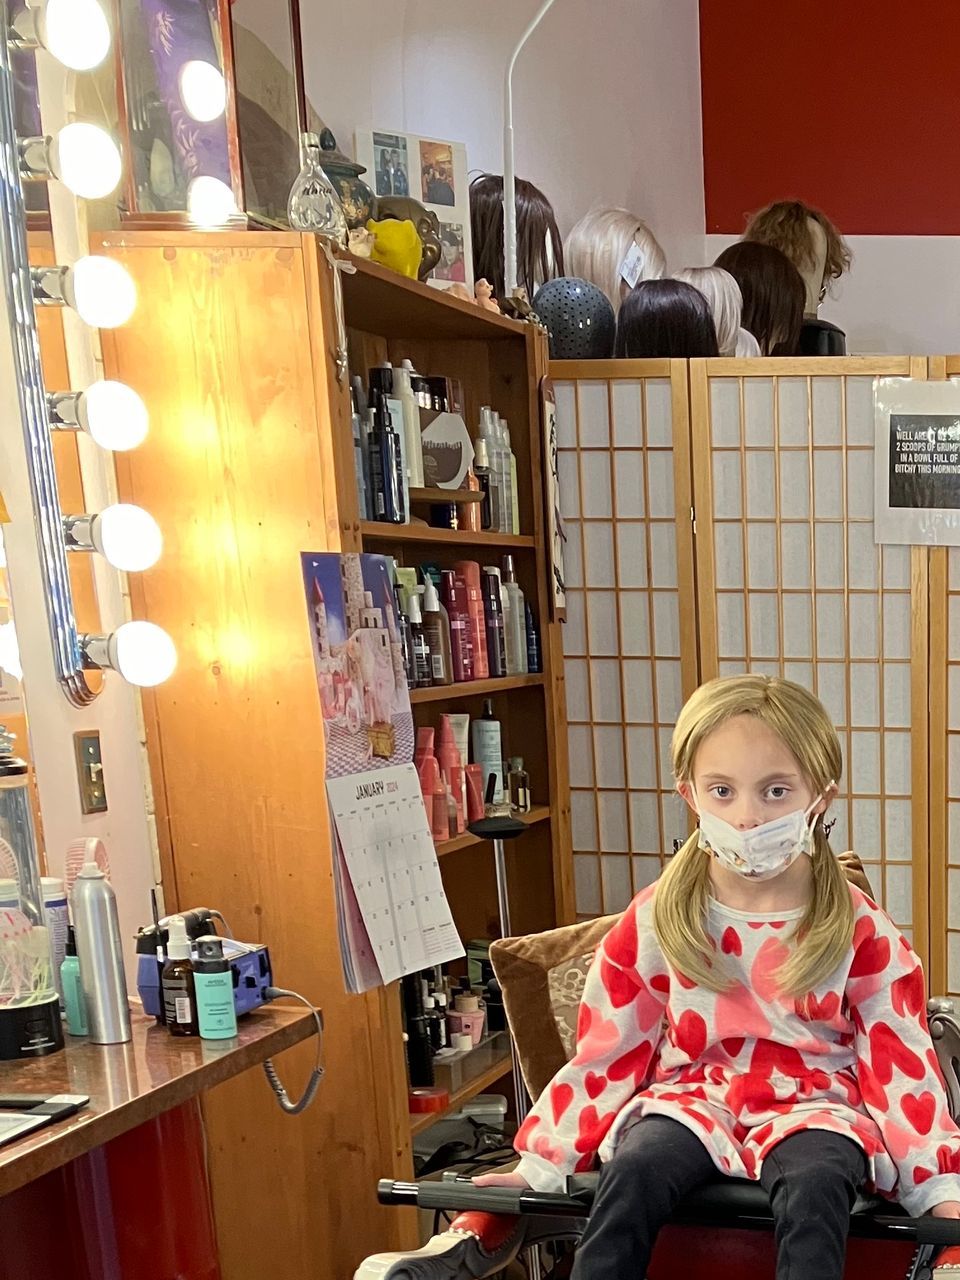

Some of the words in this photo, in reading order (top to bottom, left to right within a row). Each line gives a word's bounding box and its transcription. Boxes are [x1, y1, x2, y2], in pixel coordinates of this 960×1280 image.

[896, 431, 913, 440] WELL
[896, 442, 900, 451] 2
[901, 442, 926, 451] SCOOPS
[927, 442, 936, 452] OF
[900, 453, 908, 462] IN
[908, 453, 913, 462] A
[914, 453, 932, 463] BOWL
[933, 453, 949, 463] FULL
[949, 453, 958, 463] OF
[895, 463, 917, 473] BITCHY
[917, 464, 932, 473] THIS
[356, 780, 385, 800] JANUARY
